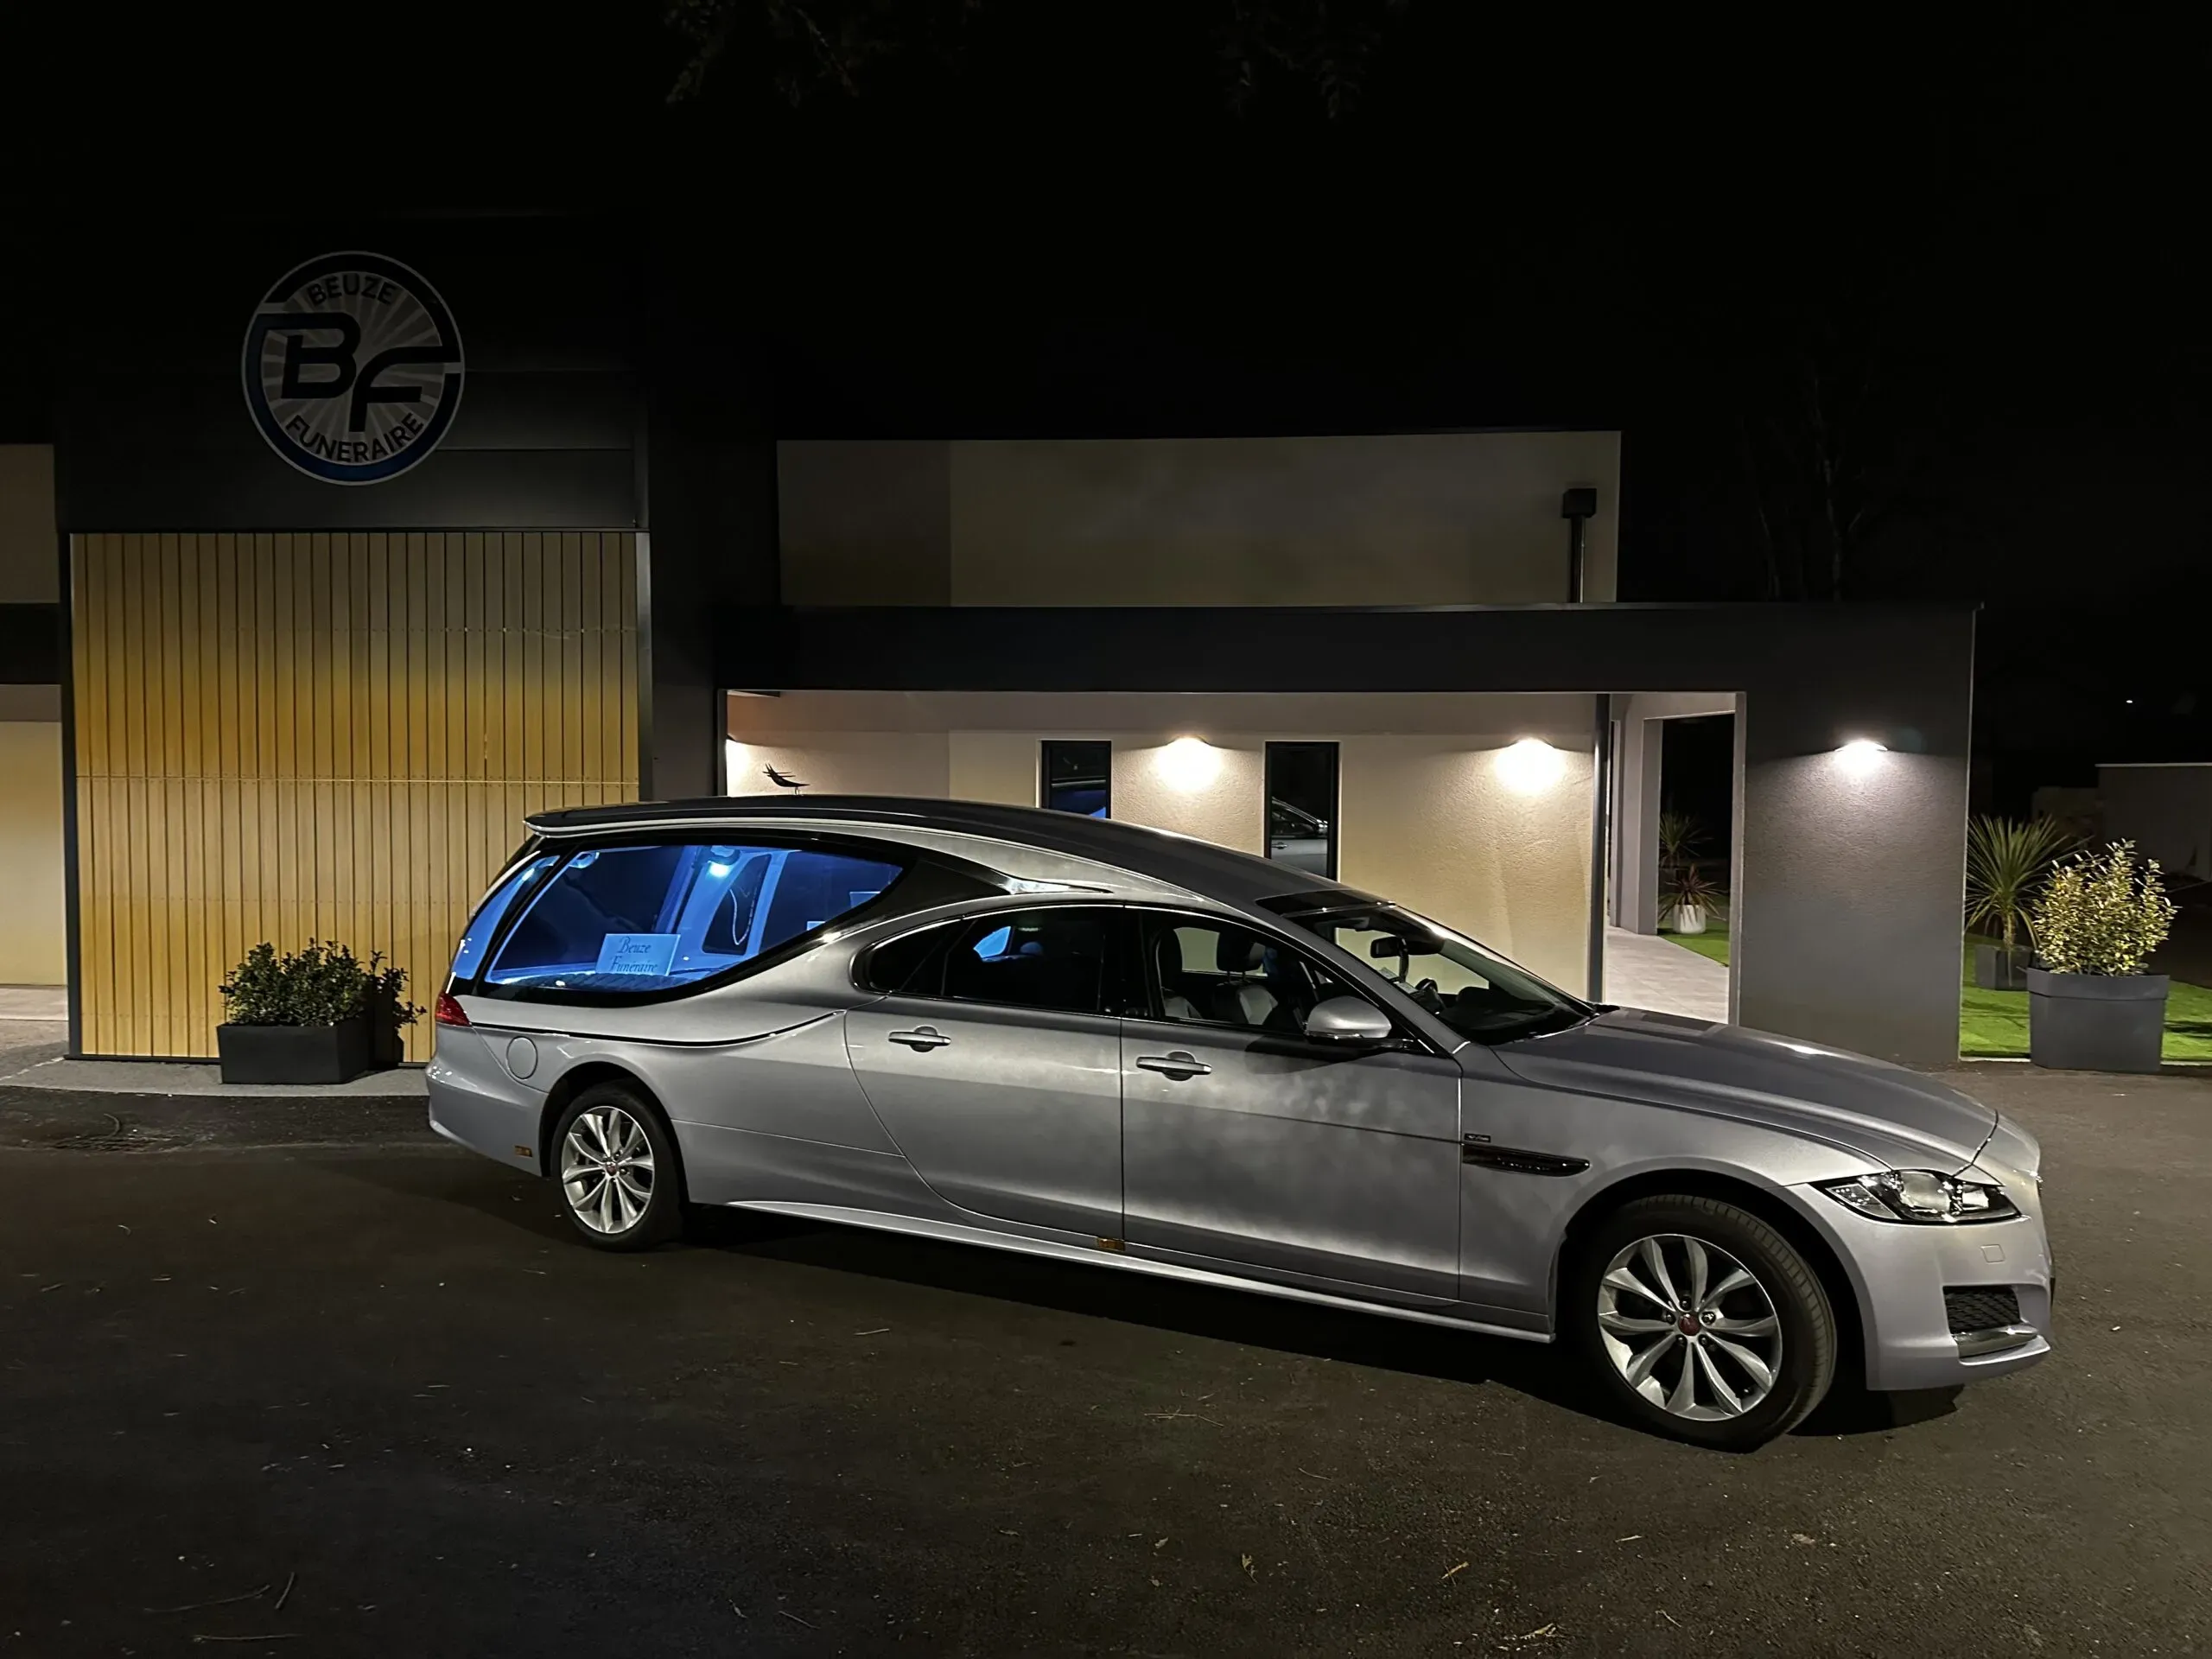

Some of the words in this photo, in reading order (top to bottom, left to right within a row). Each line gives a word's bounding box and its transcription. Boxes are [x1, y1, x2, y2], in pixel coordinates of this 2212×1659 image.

[307, 272, 397, 305] BEUZE
[264, 312, 460, 432] BF
[285, 413, 423, 462] FUNERAIRE
[617, 936, 652, 954] Beuze
